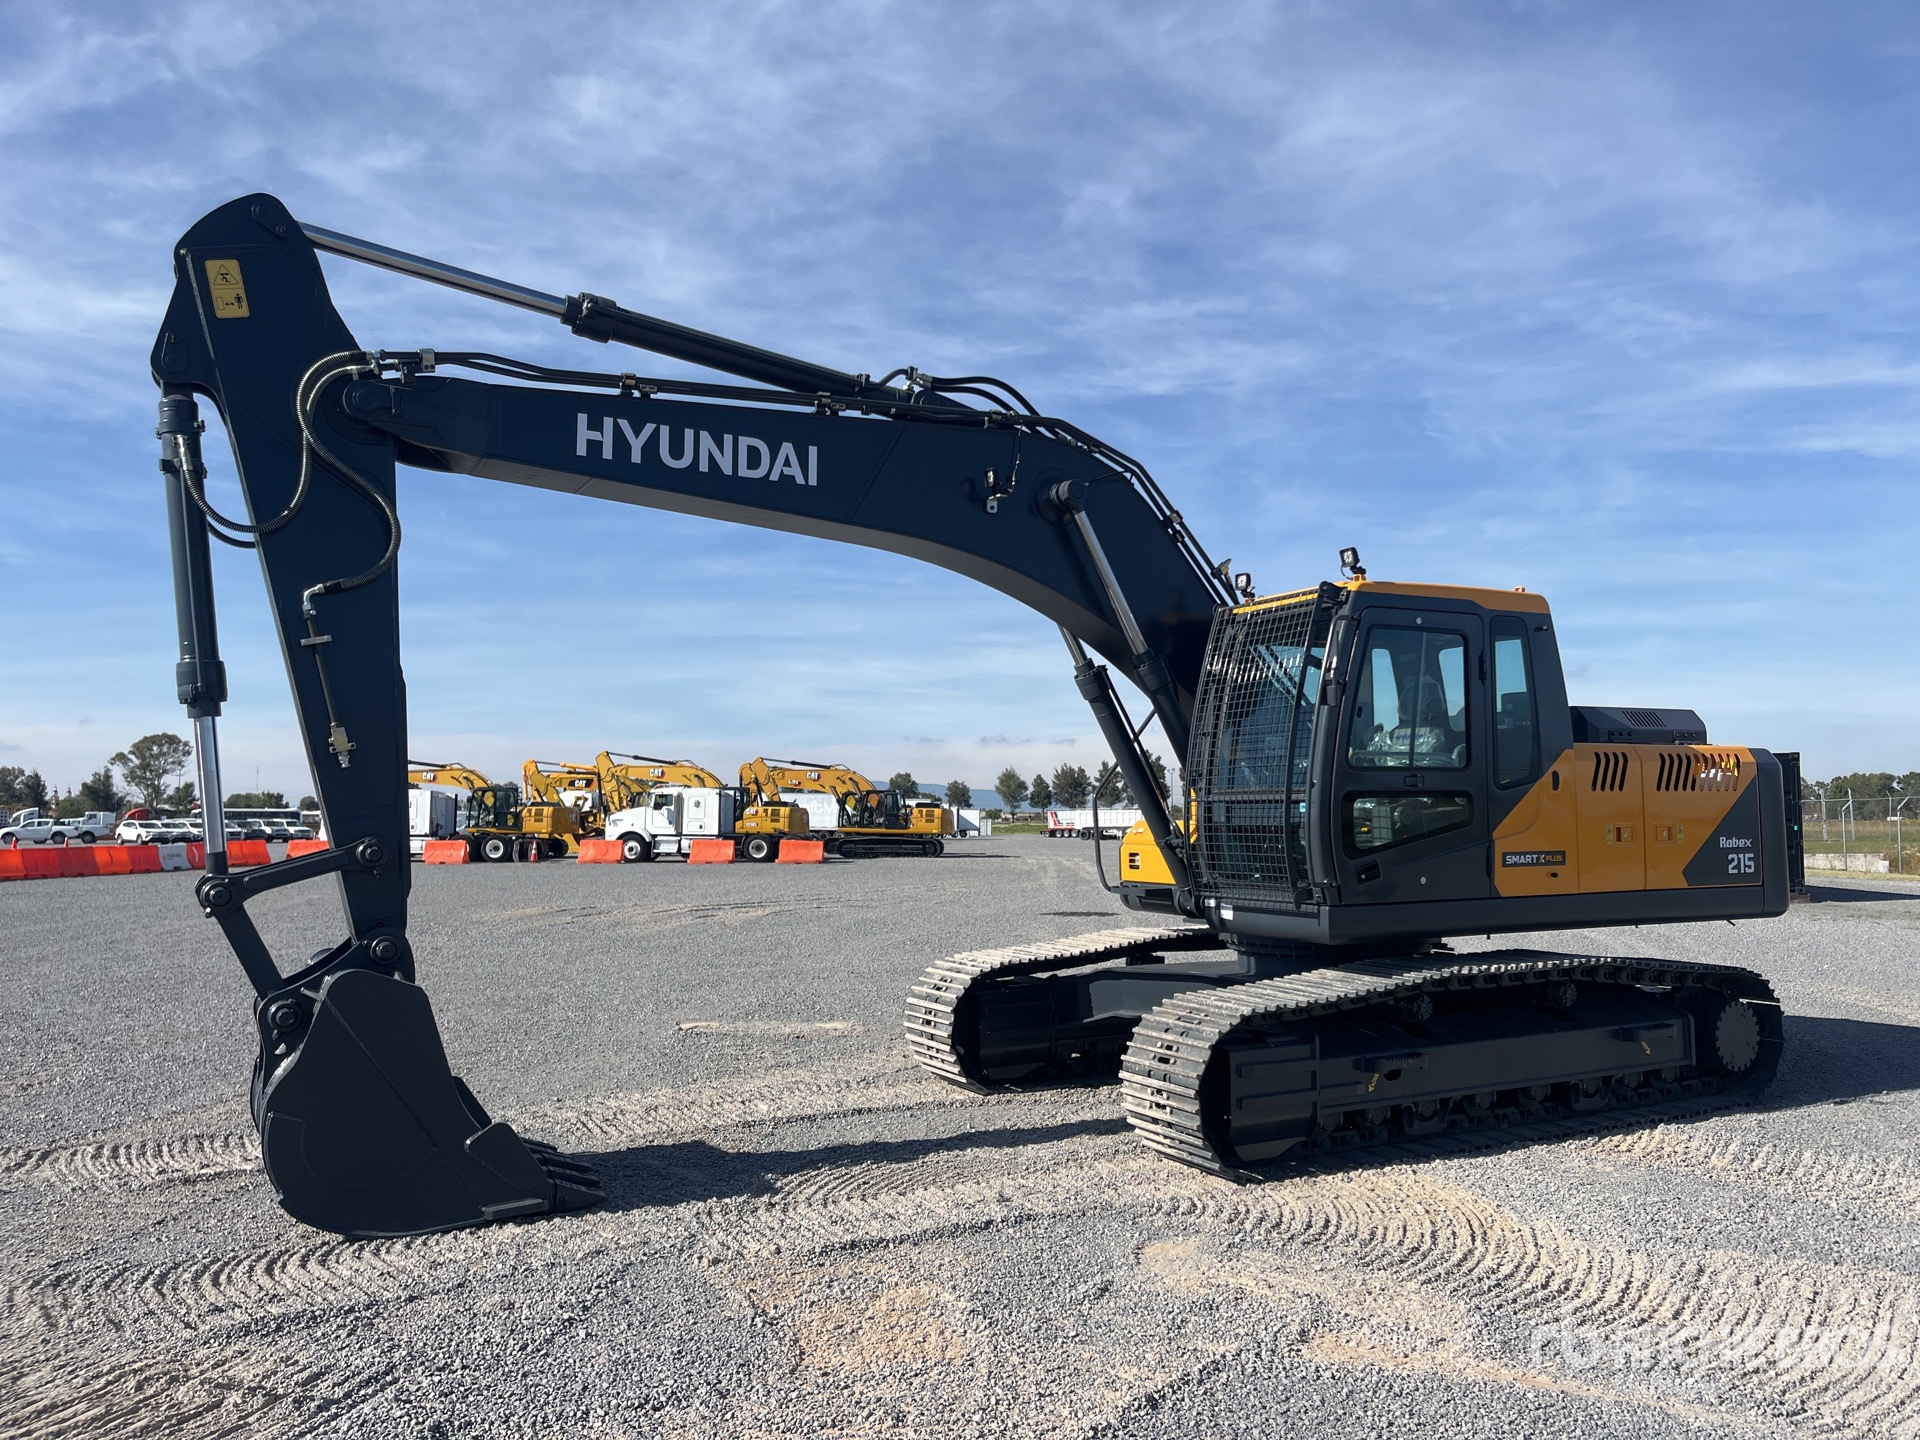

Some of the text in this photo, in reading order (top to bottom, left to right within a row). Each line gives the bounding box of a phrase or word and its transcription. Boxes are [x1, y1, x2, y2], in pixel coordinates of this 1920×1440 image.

[576, 412, 818, 487] HYUNDAI
[422, 772, 435, 781] CAT
[649, 768, 662, 777] CAT
[806, 771, 819, 781] CAT
[574, 779, 587, 787] CAT
[1505, 854, 1538, 864] SMART
[1539, 854, 1546, 863] X
[1728, 853, 1755, 874] 215
